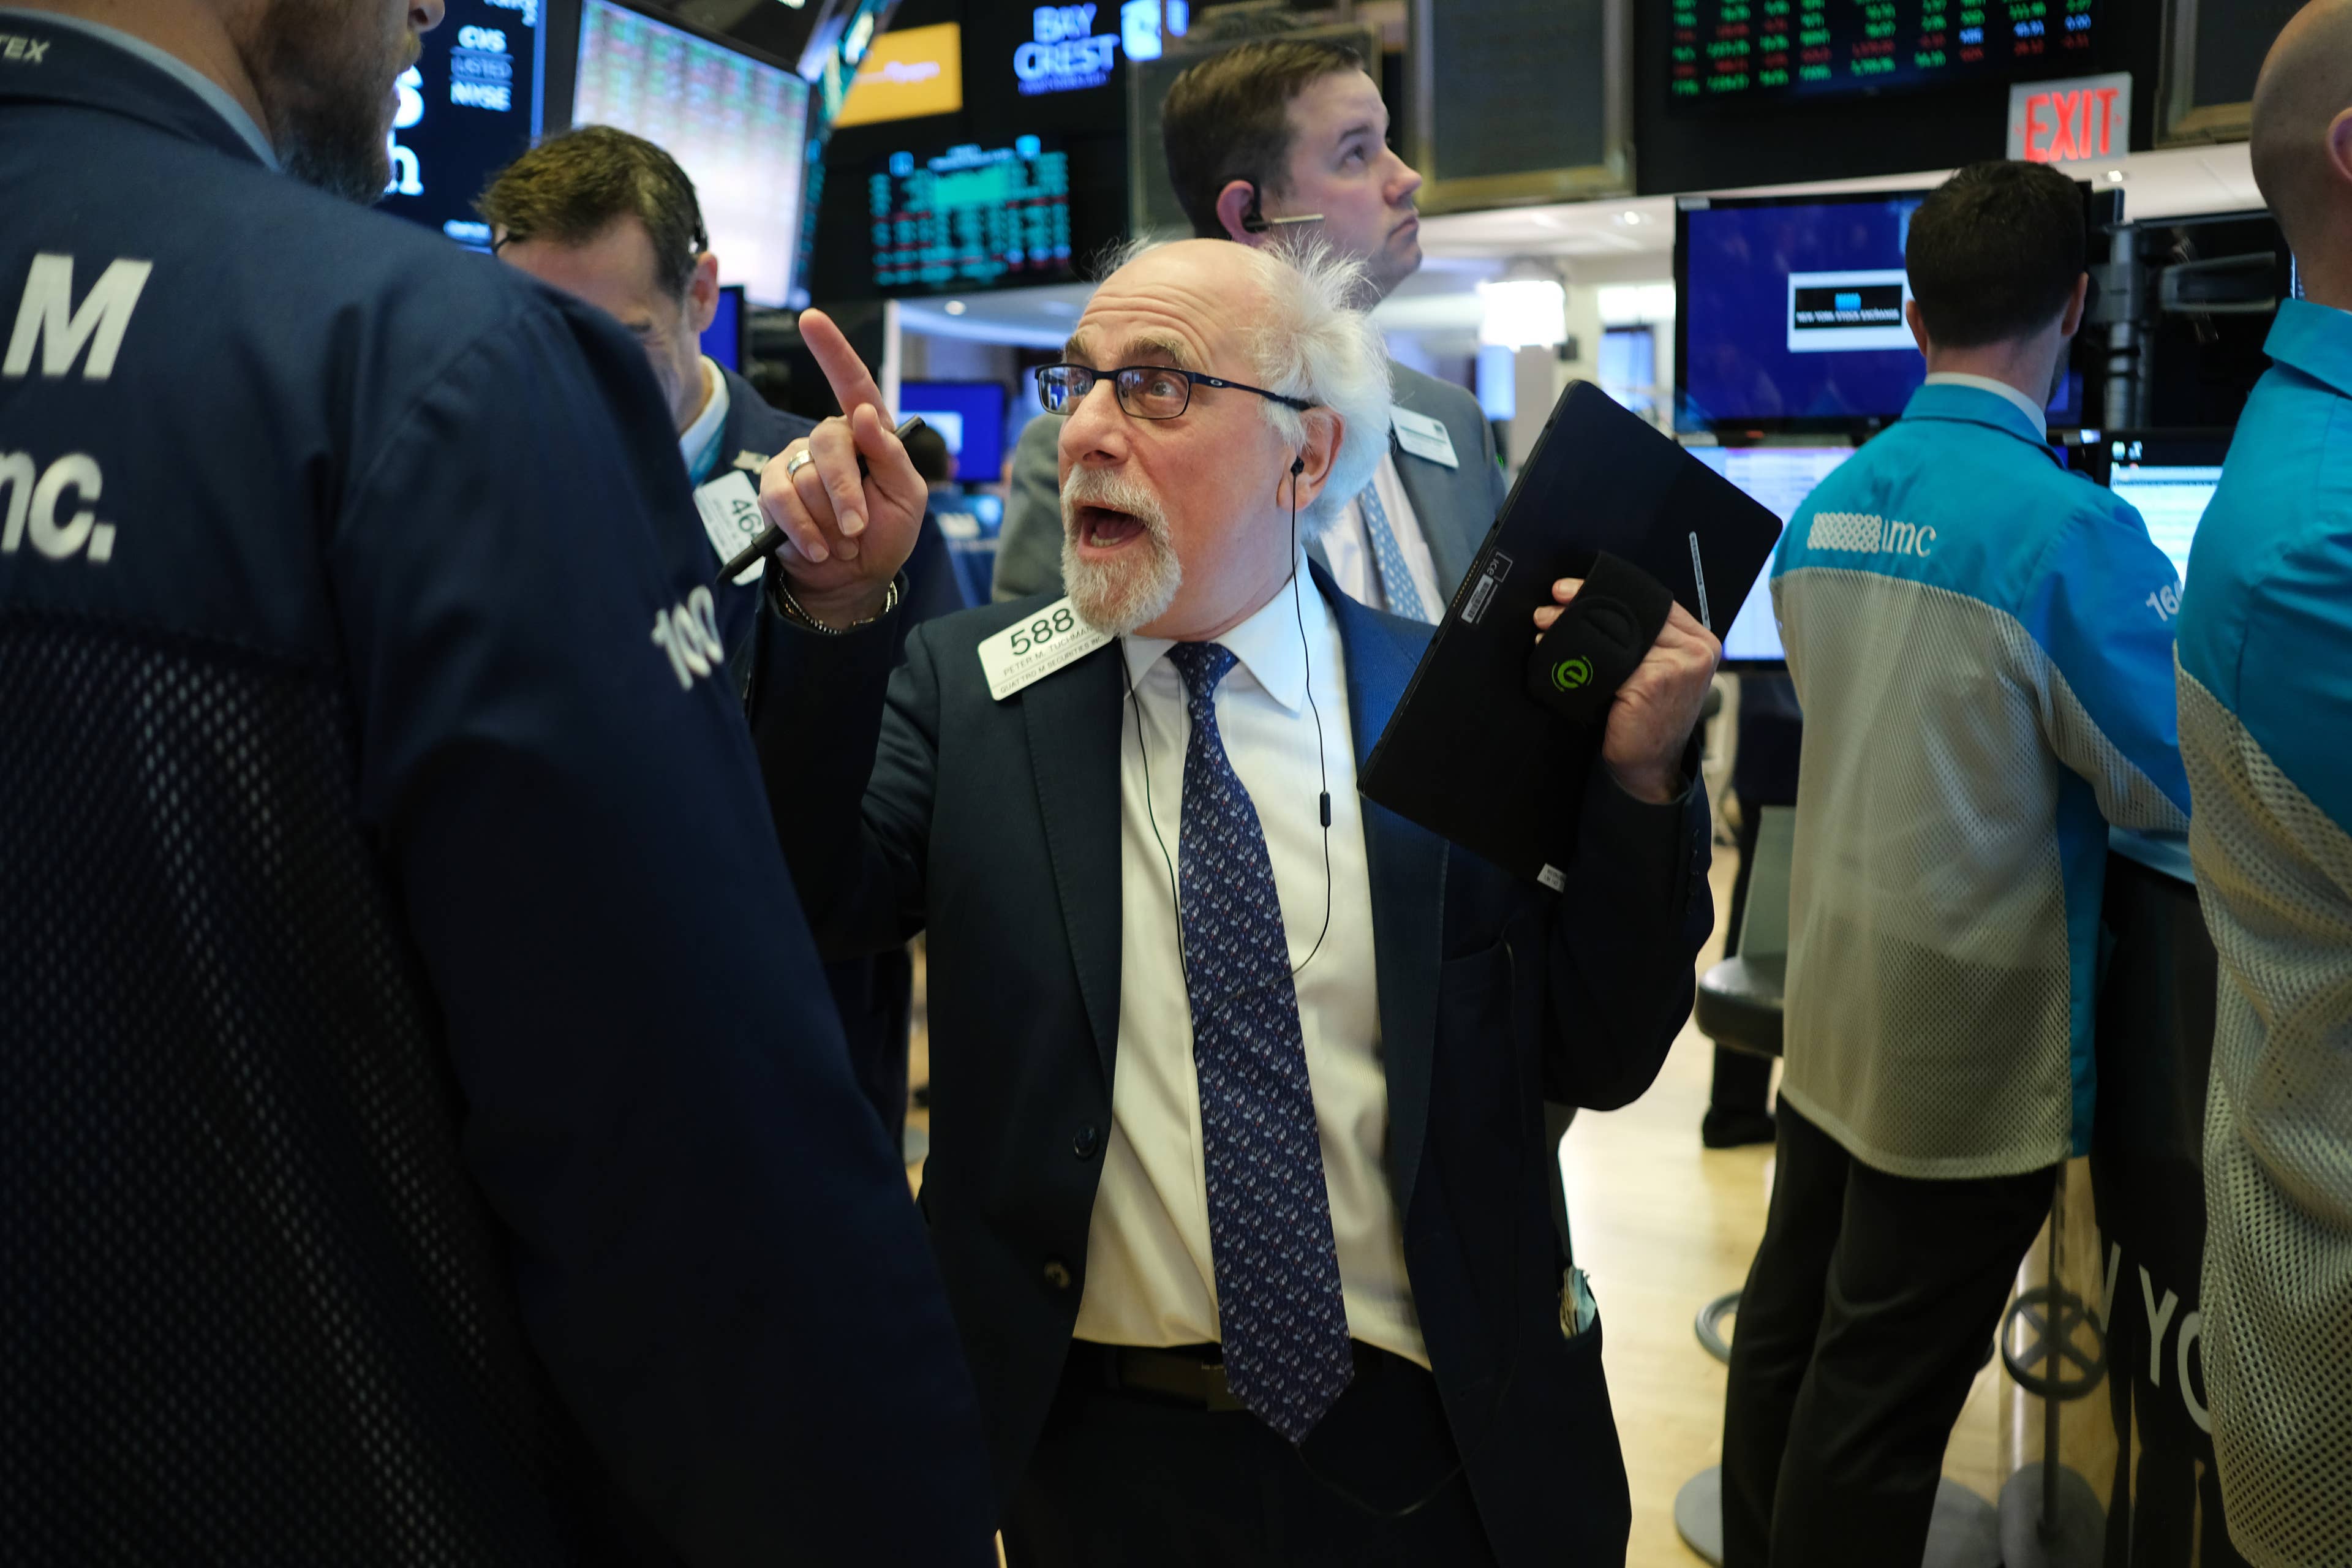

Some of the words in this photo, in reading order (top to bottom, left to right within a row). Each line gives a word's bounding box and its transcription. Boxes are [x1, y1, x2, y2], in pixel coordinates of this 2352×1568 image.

[1013, 33, 1120, 82] CREST
[450, 81, 512, 112] NYSE
[2024, 88, 2119, 164] EXIT
[2, 252, 153, 382] M
[731, 499, 762, 540] 46
[1882, 519, 1936, 557] imc
[1011, 608, 1074, 655] 588
[1003, 656, 1033, 677] PETER
